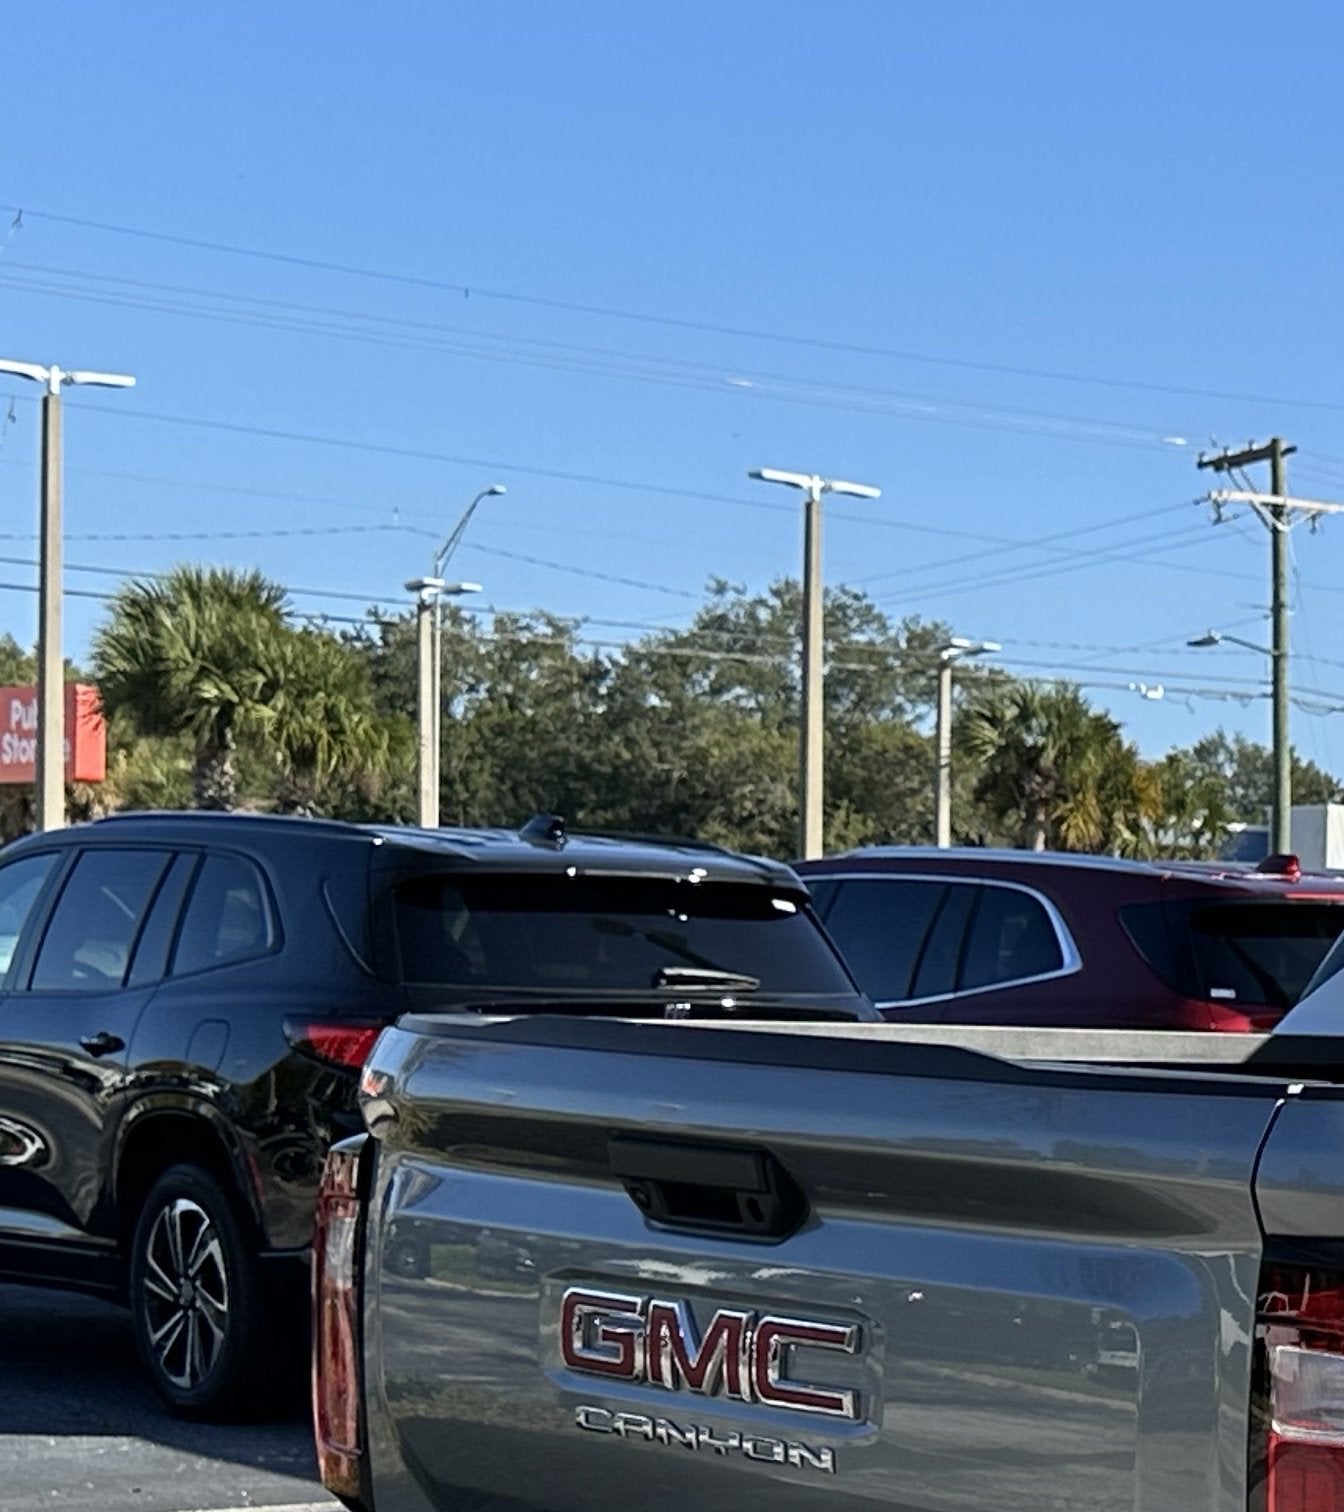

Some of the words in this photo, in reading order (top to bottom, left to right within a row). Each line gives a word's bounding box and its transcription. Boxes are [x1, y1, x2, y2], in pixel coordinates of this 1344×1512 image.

[2, 733, 71, 764] Store
[561, 1286, 861, 1420] GMC
[574, 1404, 837, 1475] CANYON
